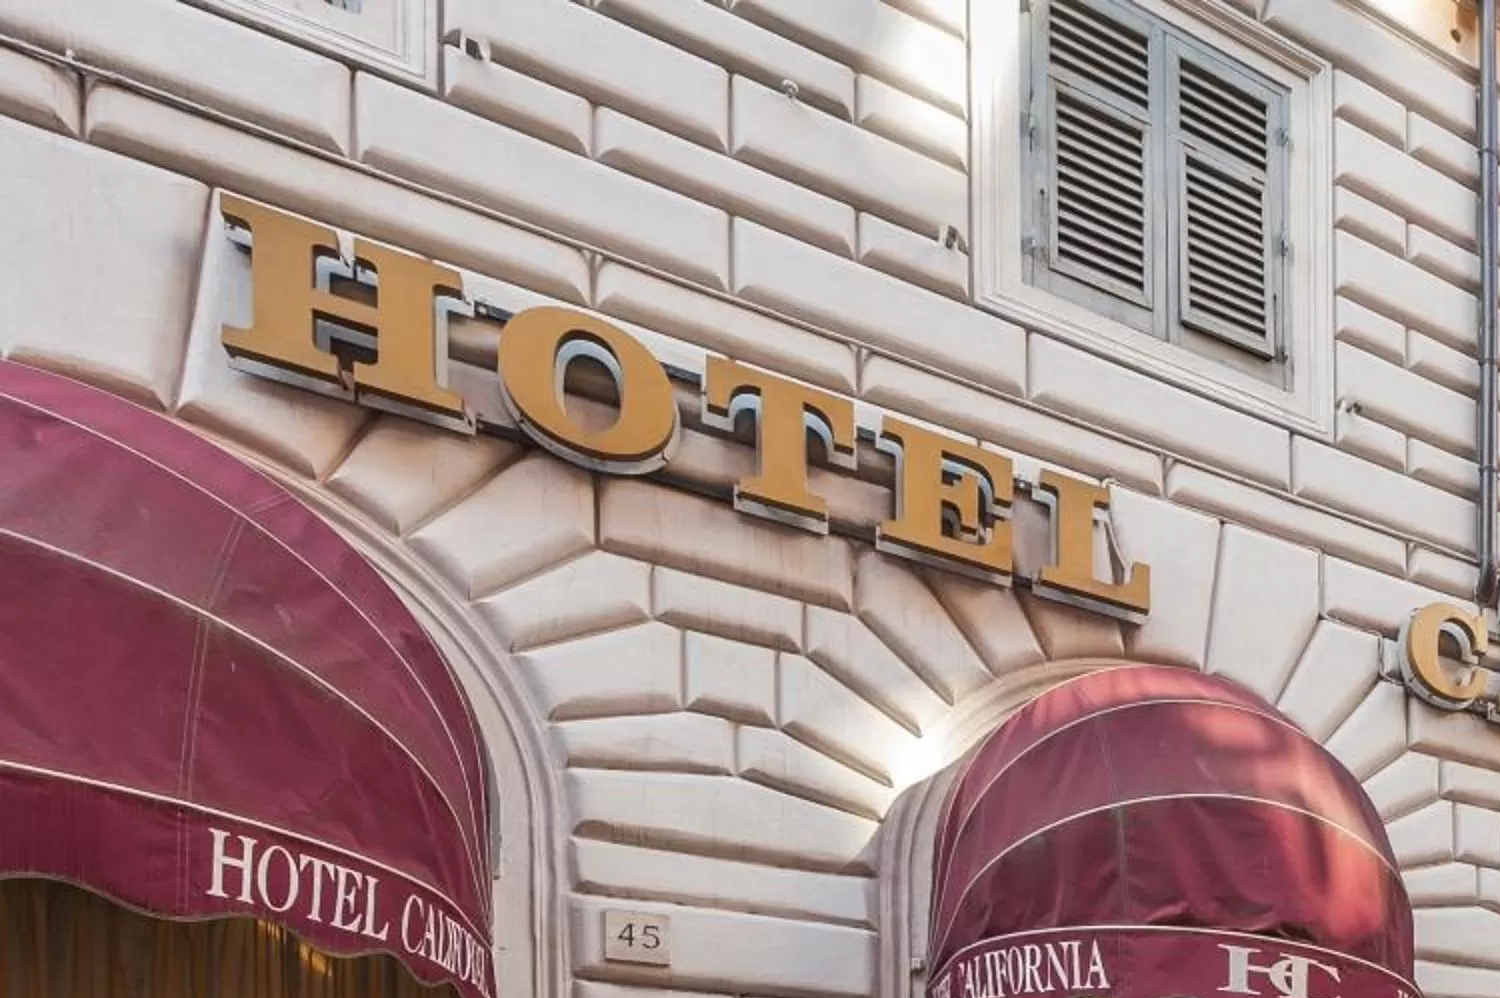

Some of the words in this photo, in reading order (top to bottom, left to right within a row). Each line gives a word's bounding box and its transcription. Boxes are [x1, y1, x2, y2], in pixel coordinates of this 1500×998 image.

[219, 197, 1152, 618] HOTEL
[205, 826, 391, 941] HOTEL
[618, 923, 661, 949] 45
